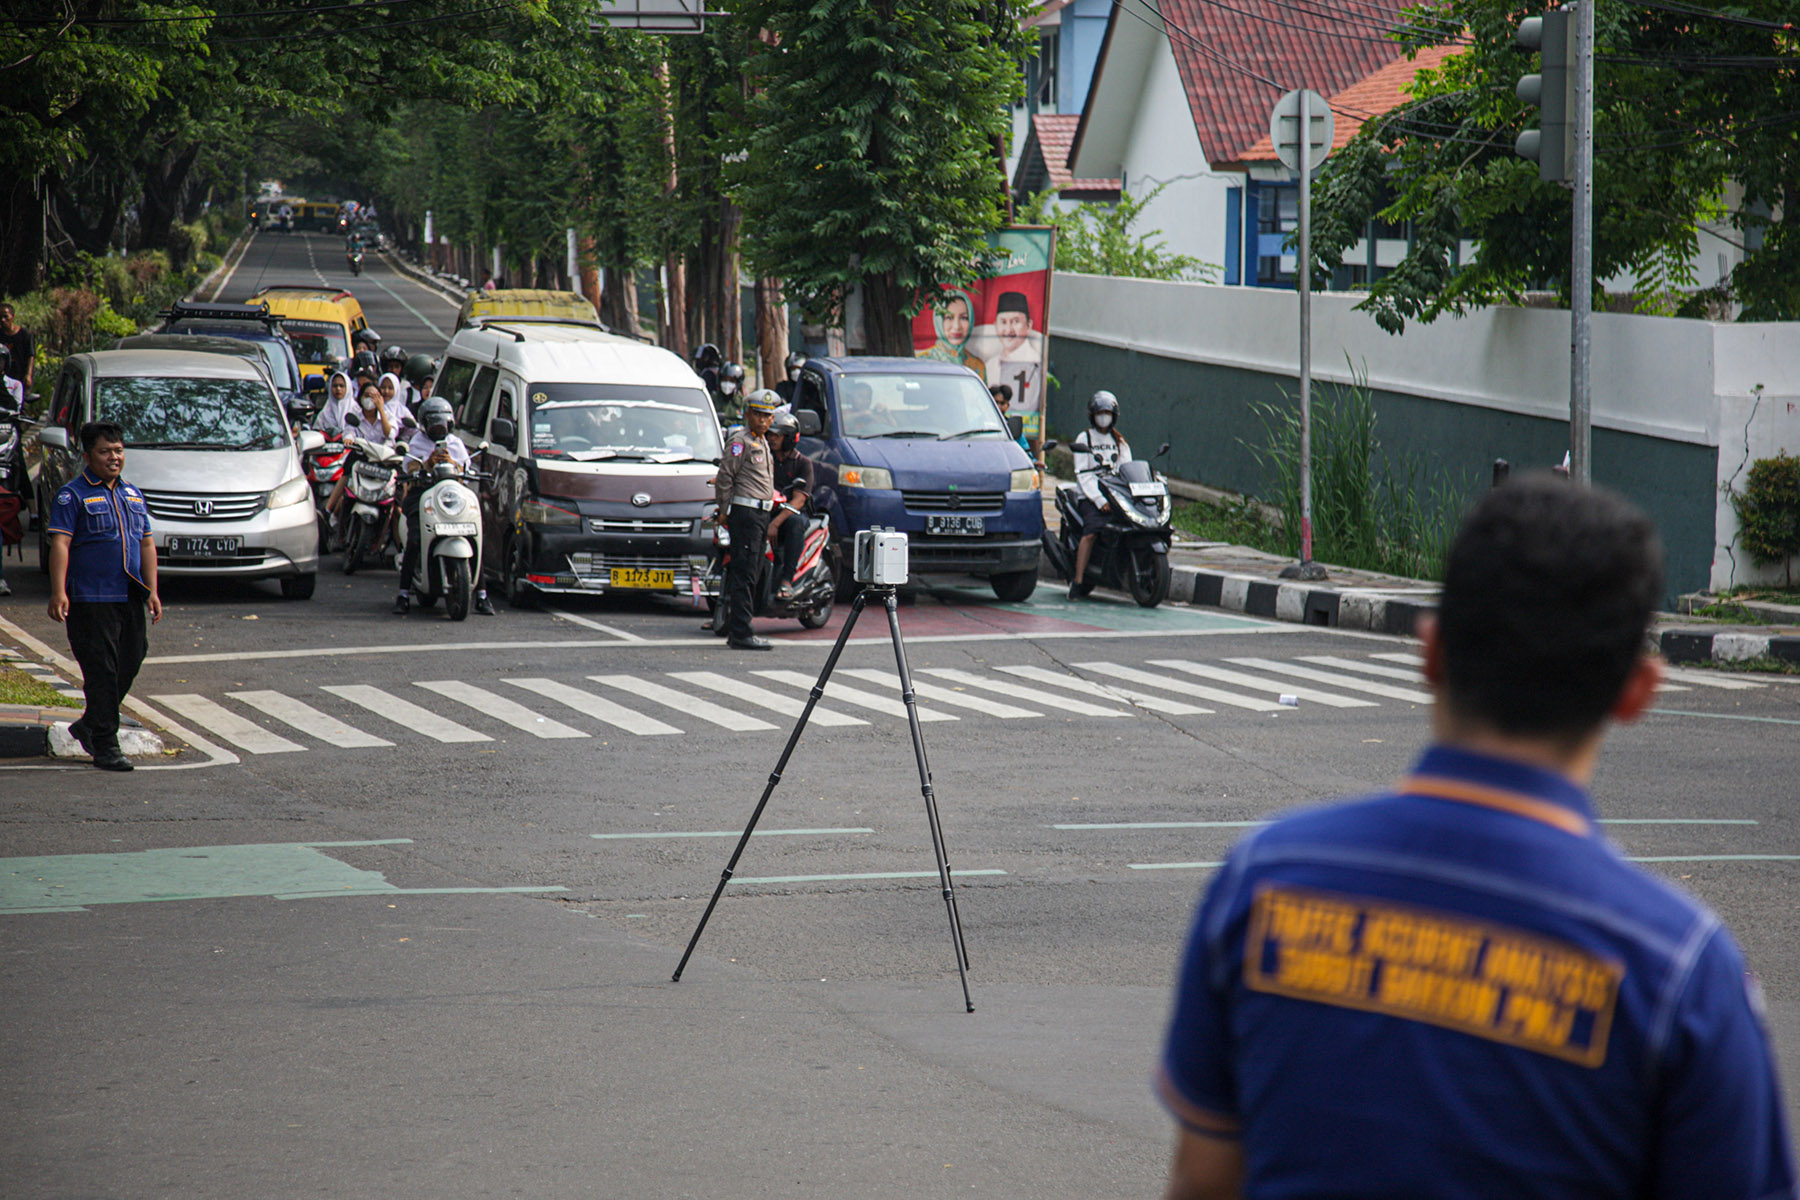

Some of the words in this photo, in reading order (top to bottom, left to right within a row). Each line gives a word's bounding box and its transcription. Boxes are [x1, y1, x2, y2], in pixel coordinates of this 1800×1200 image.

[1013, 370, 1026, 403] 1
[172, 538, 179, 551] B
[187, 538, 209, 551] 1774
[217, 538, 236, 551] CYD
[612, 570, 619, 580] B
[624, 570, 650, 582] 1173
[652, 571, 672, 583] JTX
